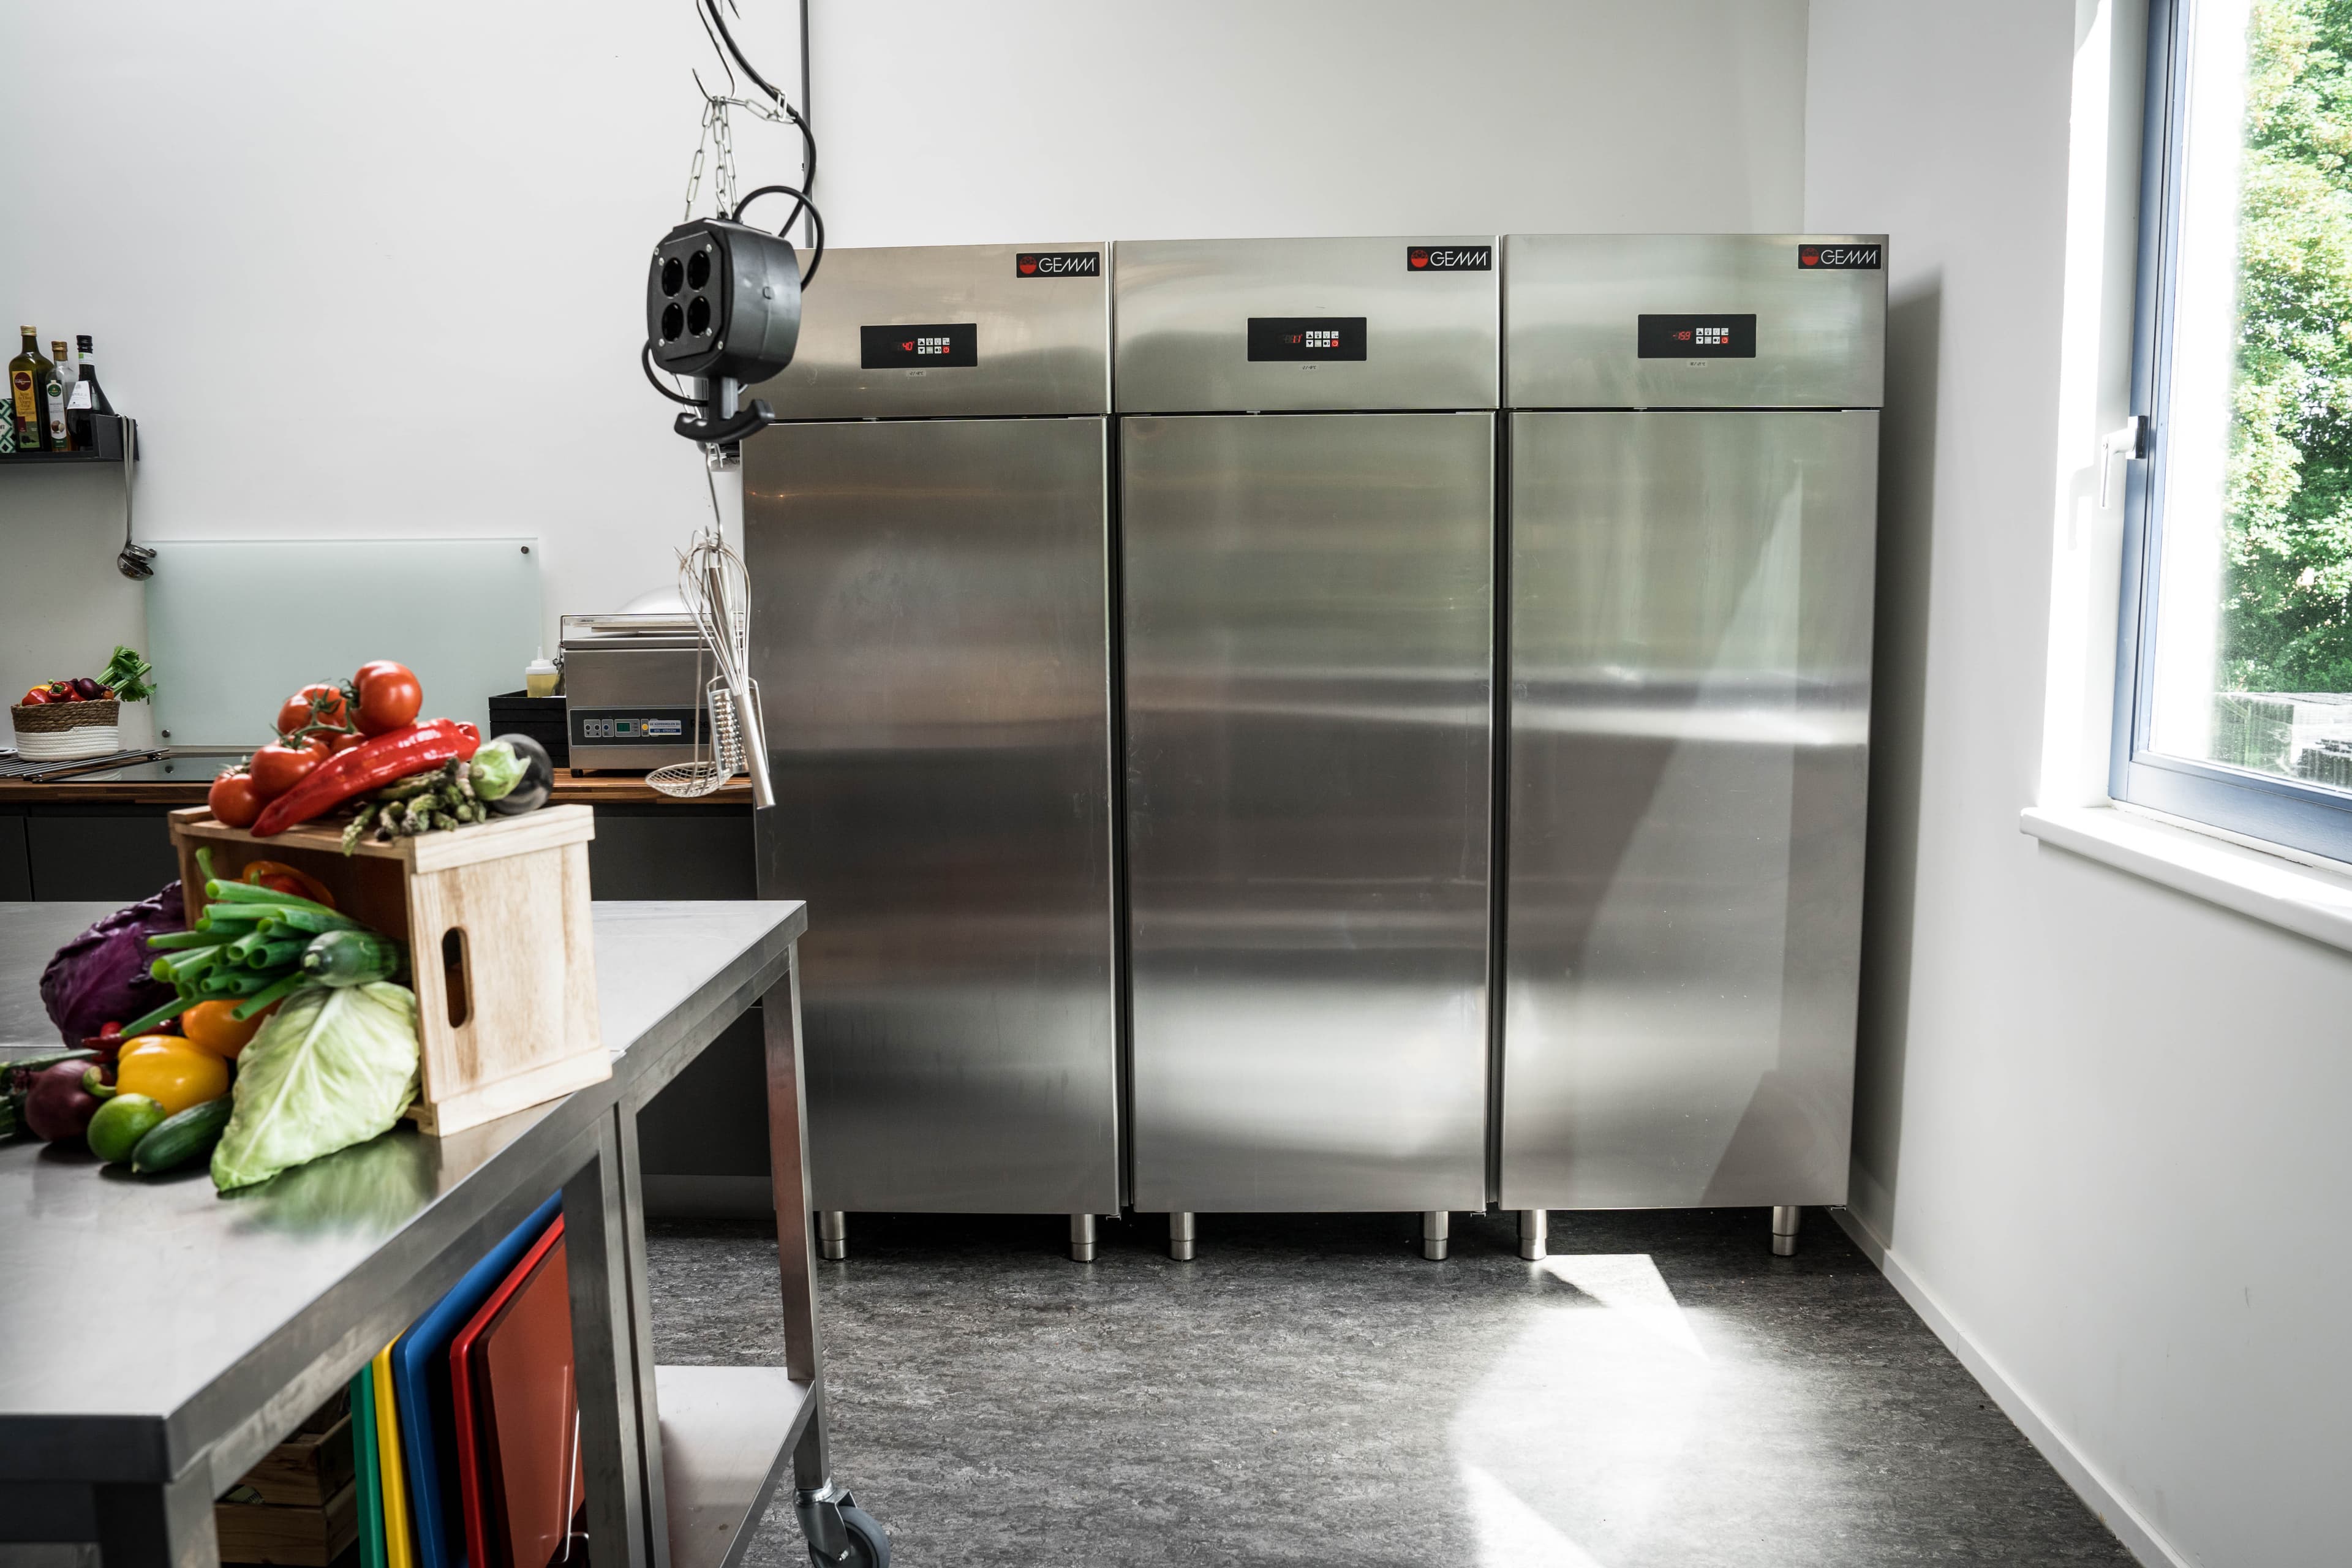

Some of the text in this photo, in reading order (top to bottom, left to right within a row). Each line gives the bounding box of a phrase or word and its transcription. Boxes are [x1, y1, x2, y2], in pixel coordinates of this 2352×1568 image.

[1039, 257, 1095, 273] GEMM
[1430, 251, 1487, 266] GEMM
[1821, 249, 1876, 265] GEMM
